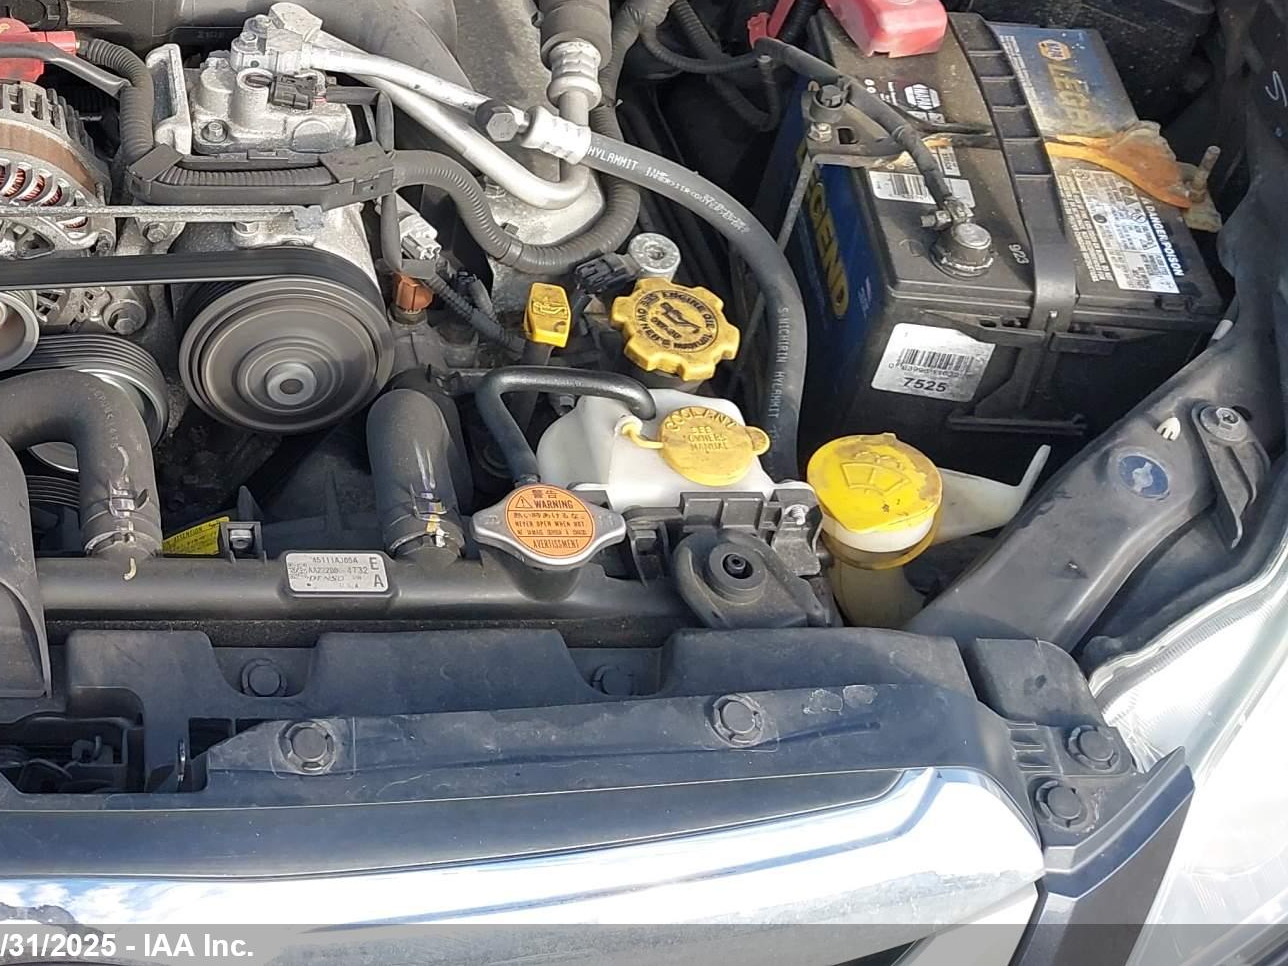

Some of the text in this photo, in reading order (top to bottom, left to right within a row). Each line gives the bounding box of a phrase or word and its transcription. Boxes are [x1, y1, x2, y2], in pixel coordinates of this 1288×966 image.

[702, 313, 716, 329] OIL
[903, 377, 947, 393] 7525
[664, 408, 737, 432] COOLANT
[690, 442, 729, 452] MANUAL
[533, 499, 574, 509] WARNING
[369, 557, 379, 570] E
